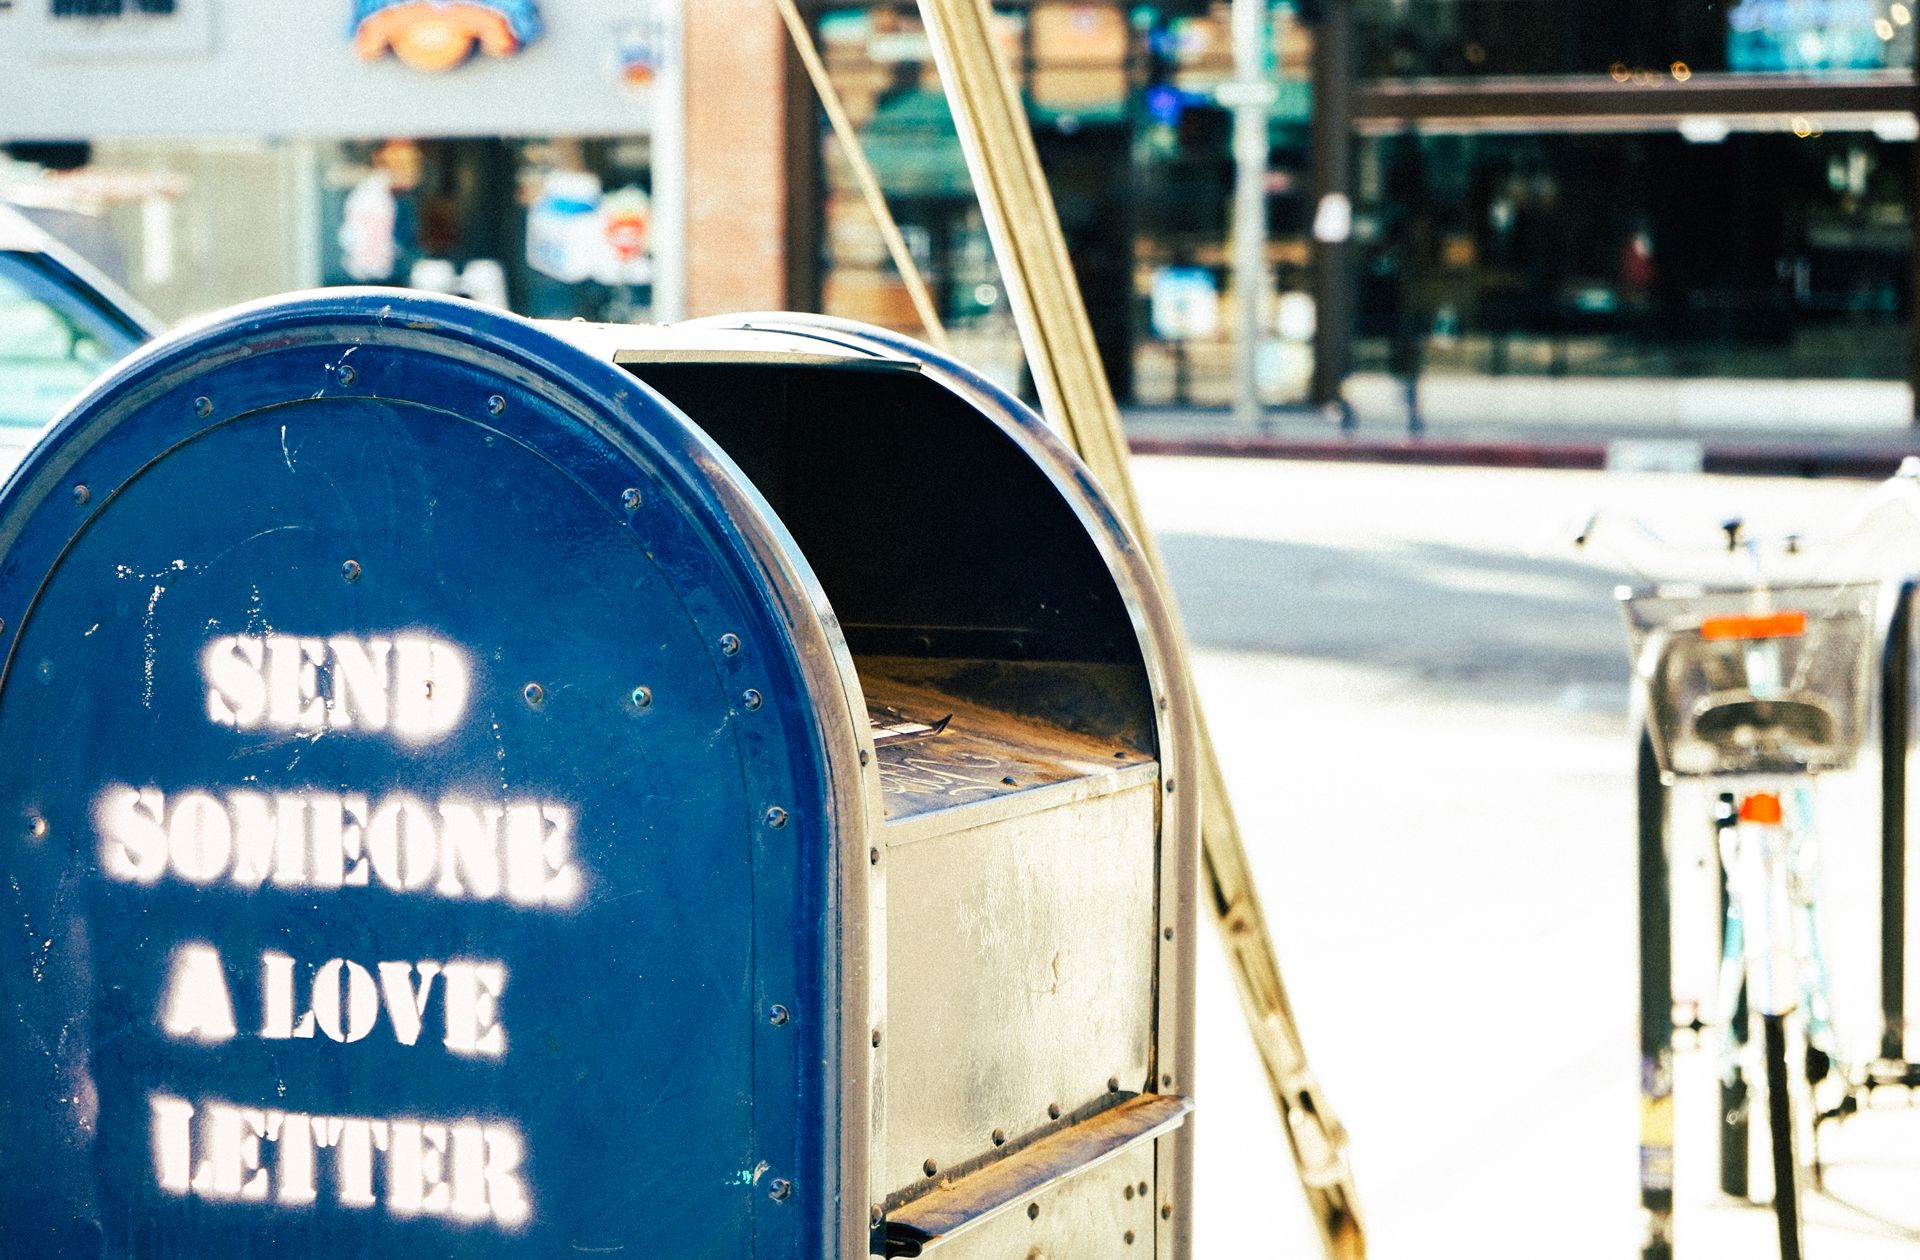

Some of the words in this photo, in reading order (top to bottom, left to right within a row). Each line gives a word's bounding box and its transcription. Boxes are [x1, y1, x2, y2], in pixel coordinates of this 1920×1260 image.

[203, 634, 469, 736] SEND
[98, 786, 582, 906] SOMEONE
[163, 943, 236, 1040] A
[260, 952, 507, 1056] LOVE
[150, 1096, 530, 1226] LETTER
